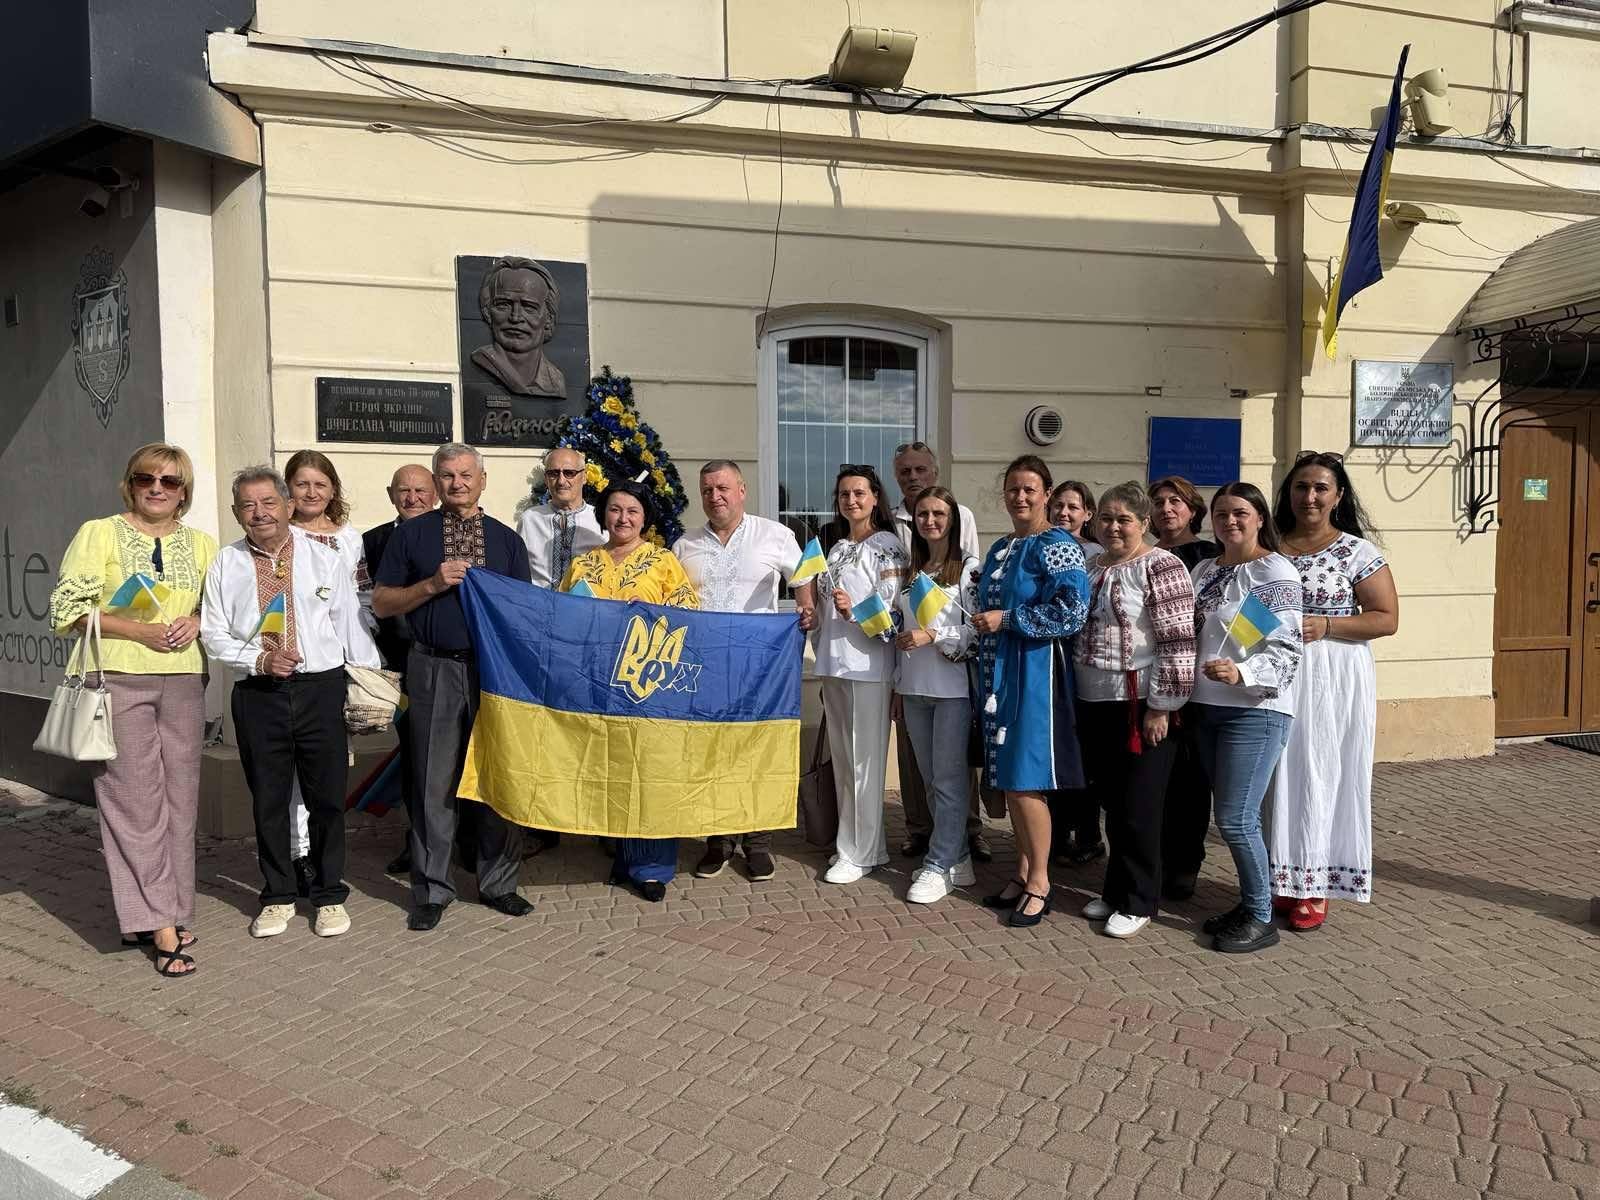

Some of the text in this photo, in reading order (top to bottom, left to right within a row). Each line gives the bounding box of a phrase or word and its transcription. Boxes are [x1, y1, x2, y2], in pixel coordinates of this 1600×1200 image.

[348, 401, 380, 413] ГЕРОЯ
[325, 417, 446, 435] ВЯЧЕСЛАВА ЧОРНОВОЛА
